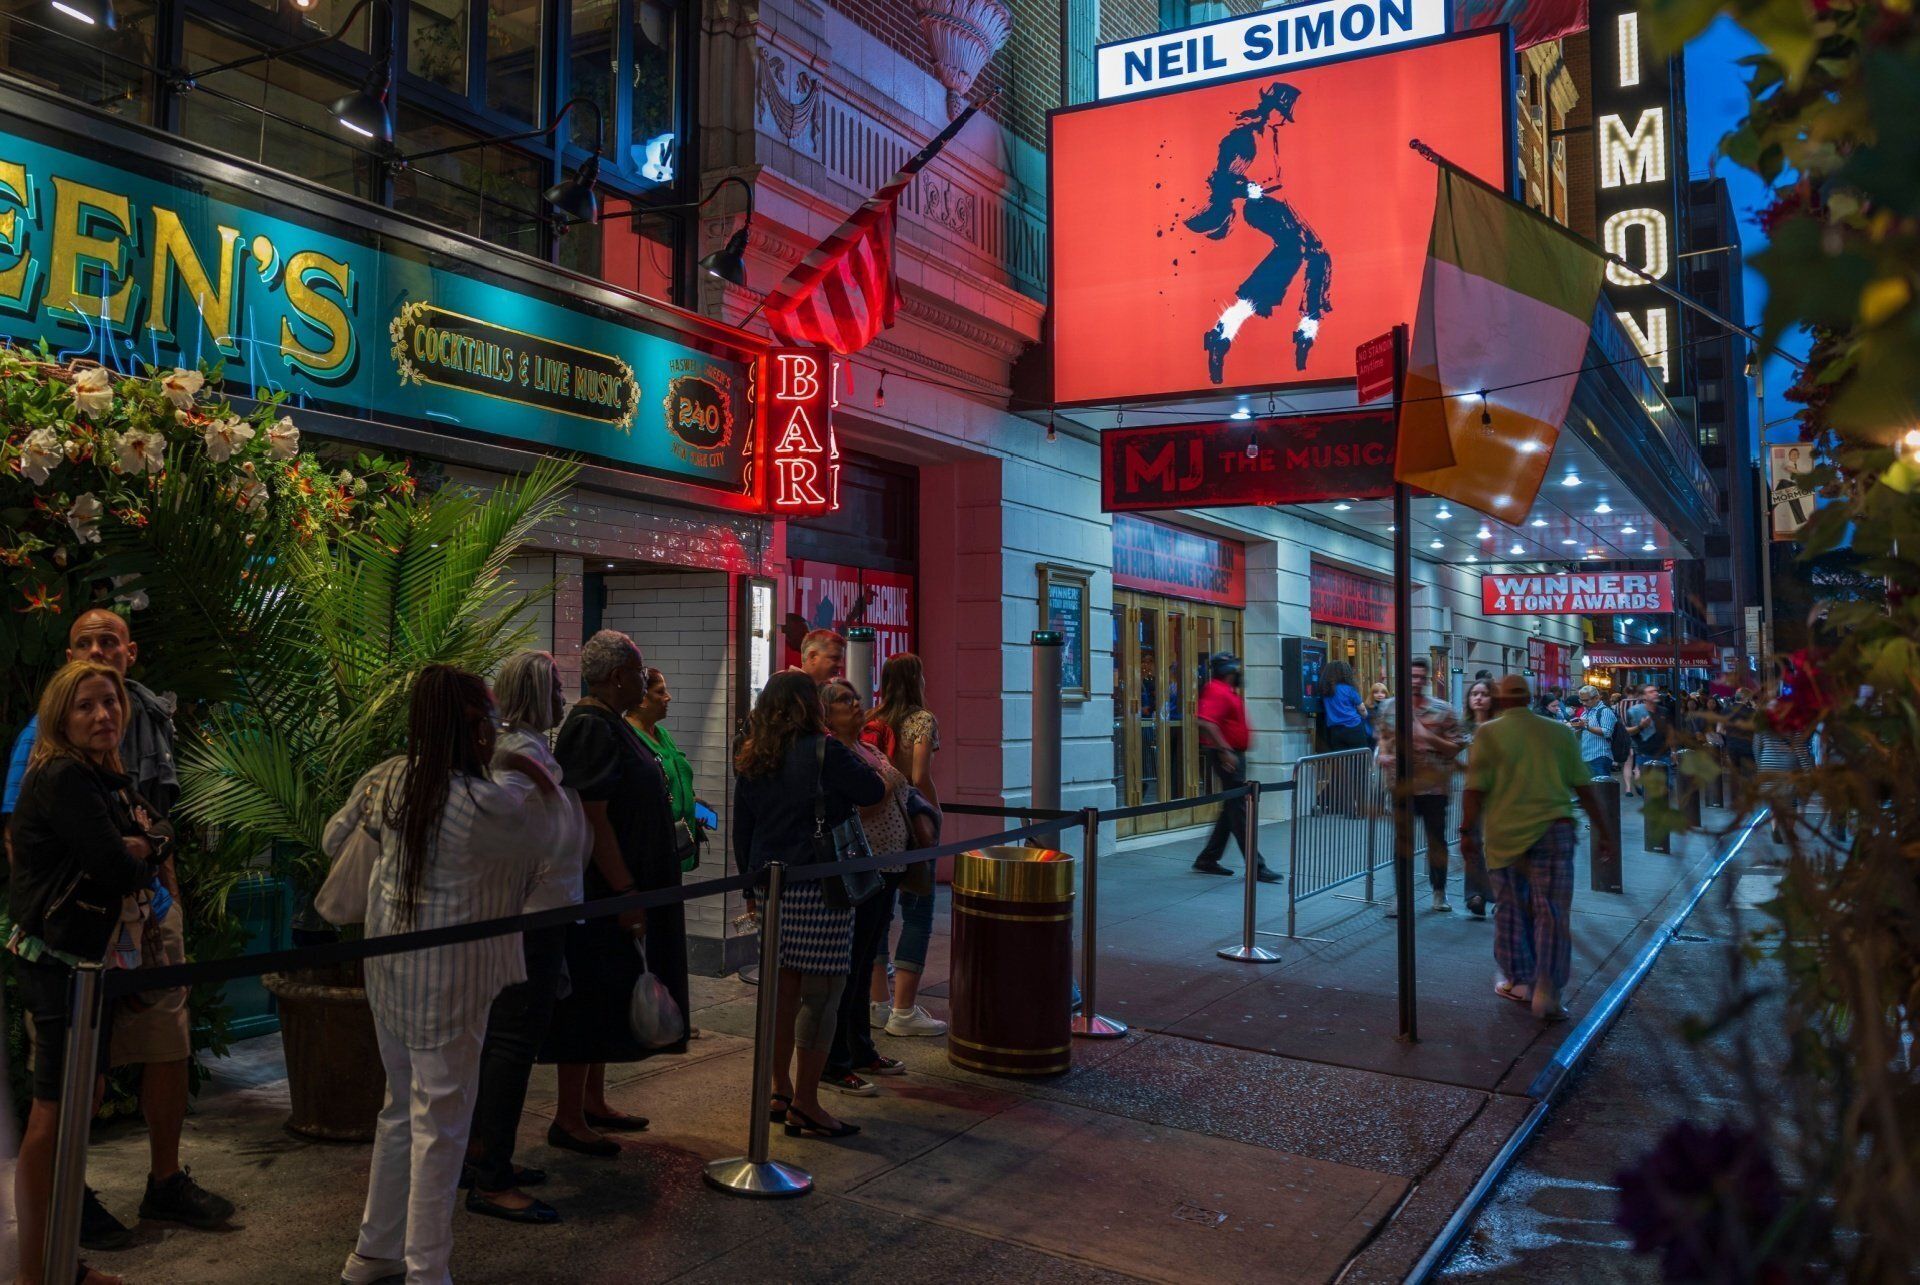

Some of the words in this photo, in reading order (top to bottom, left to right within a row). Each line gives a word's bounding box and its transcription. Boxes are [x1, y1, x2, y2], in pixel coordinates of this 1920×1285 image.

[1124, 35, 1227, 86] NEIL
[1242, 0, 1414, 61] SIMON
[413, 324, 514, 383] COCKTAILS
[518, 351, 530, 387] &
[534, 354, 571, 397] LIVE
[574, 366, 623, 409] MUSIC
[1358, 350, 1367, 363] NO
[1360, 357, 1384, 375] Anytime
[678, 396, 720, 434] 240
[774, 354, 825, 505] BAR
[1124, 438, 1204, 494] MJ
[1218, 449, 1276, 474] THE
[1131, 549, 1194, 588] HURRICANE
[1494, 574, 1658, 596] WINNER!
[866, 583, 909, 627] MACHINE
[1494, 595, 1507, 611] 4
[1511, 595, 1567, 611] TONY
[1571, 593, 1660, 611] AWARDS
[1592, 655, 1629, 665] RUSSIAN
[1631, 655, 1675, 665] SAMOVAR
